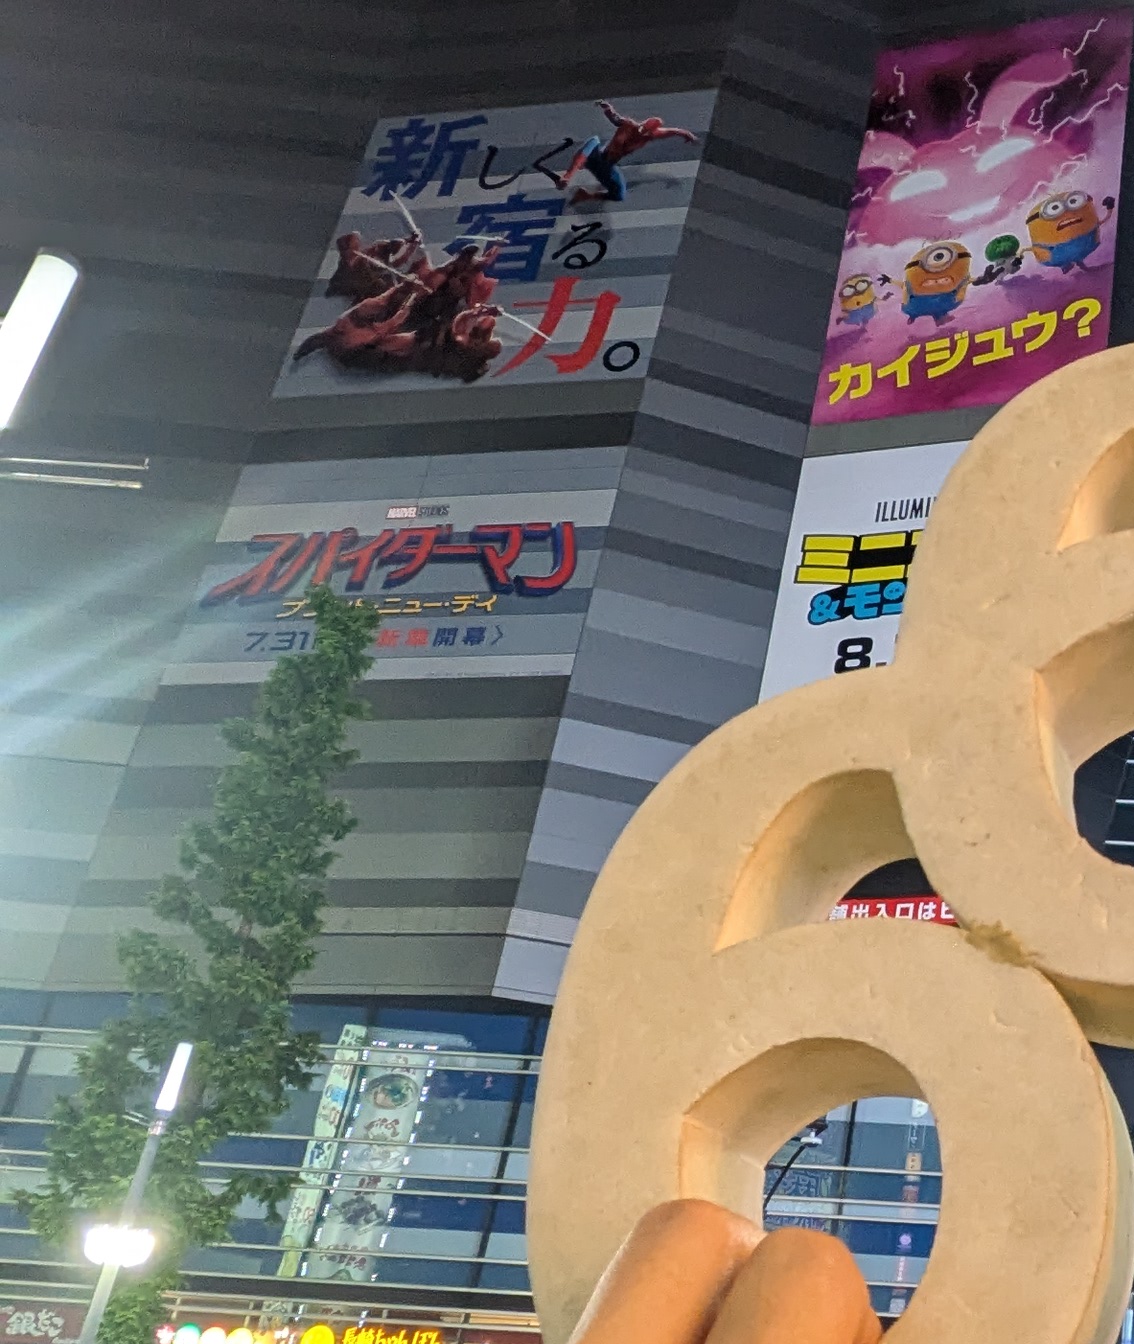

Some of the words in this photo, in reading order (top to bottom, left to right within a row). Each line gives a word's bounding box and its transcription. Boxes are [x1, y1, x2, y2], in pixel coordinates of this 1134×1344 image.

[362, 114, 575, 201] 新しく
[445, 193, 608, 283] 宿る
[874, 495, 938, 523] ILLUMI
[200, 519, 578, 606] スパイダーマン
[793, 528, 926, 586] ミニ
